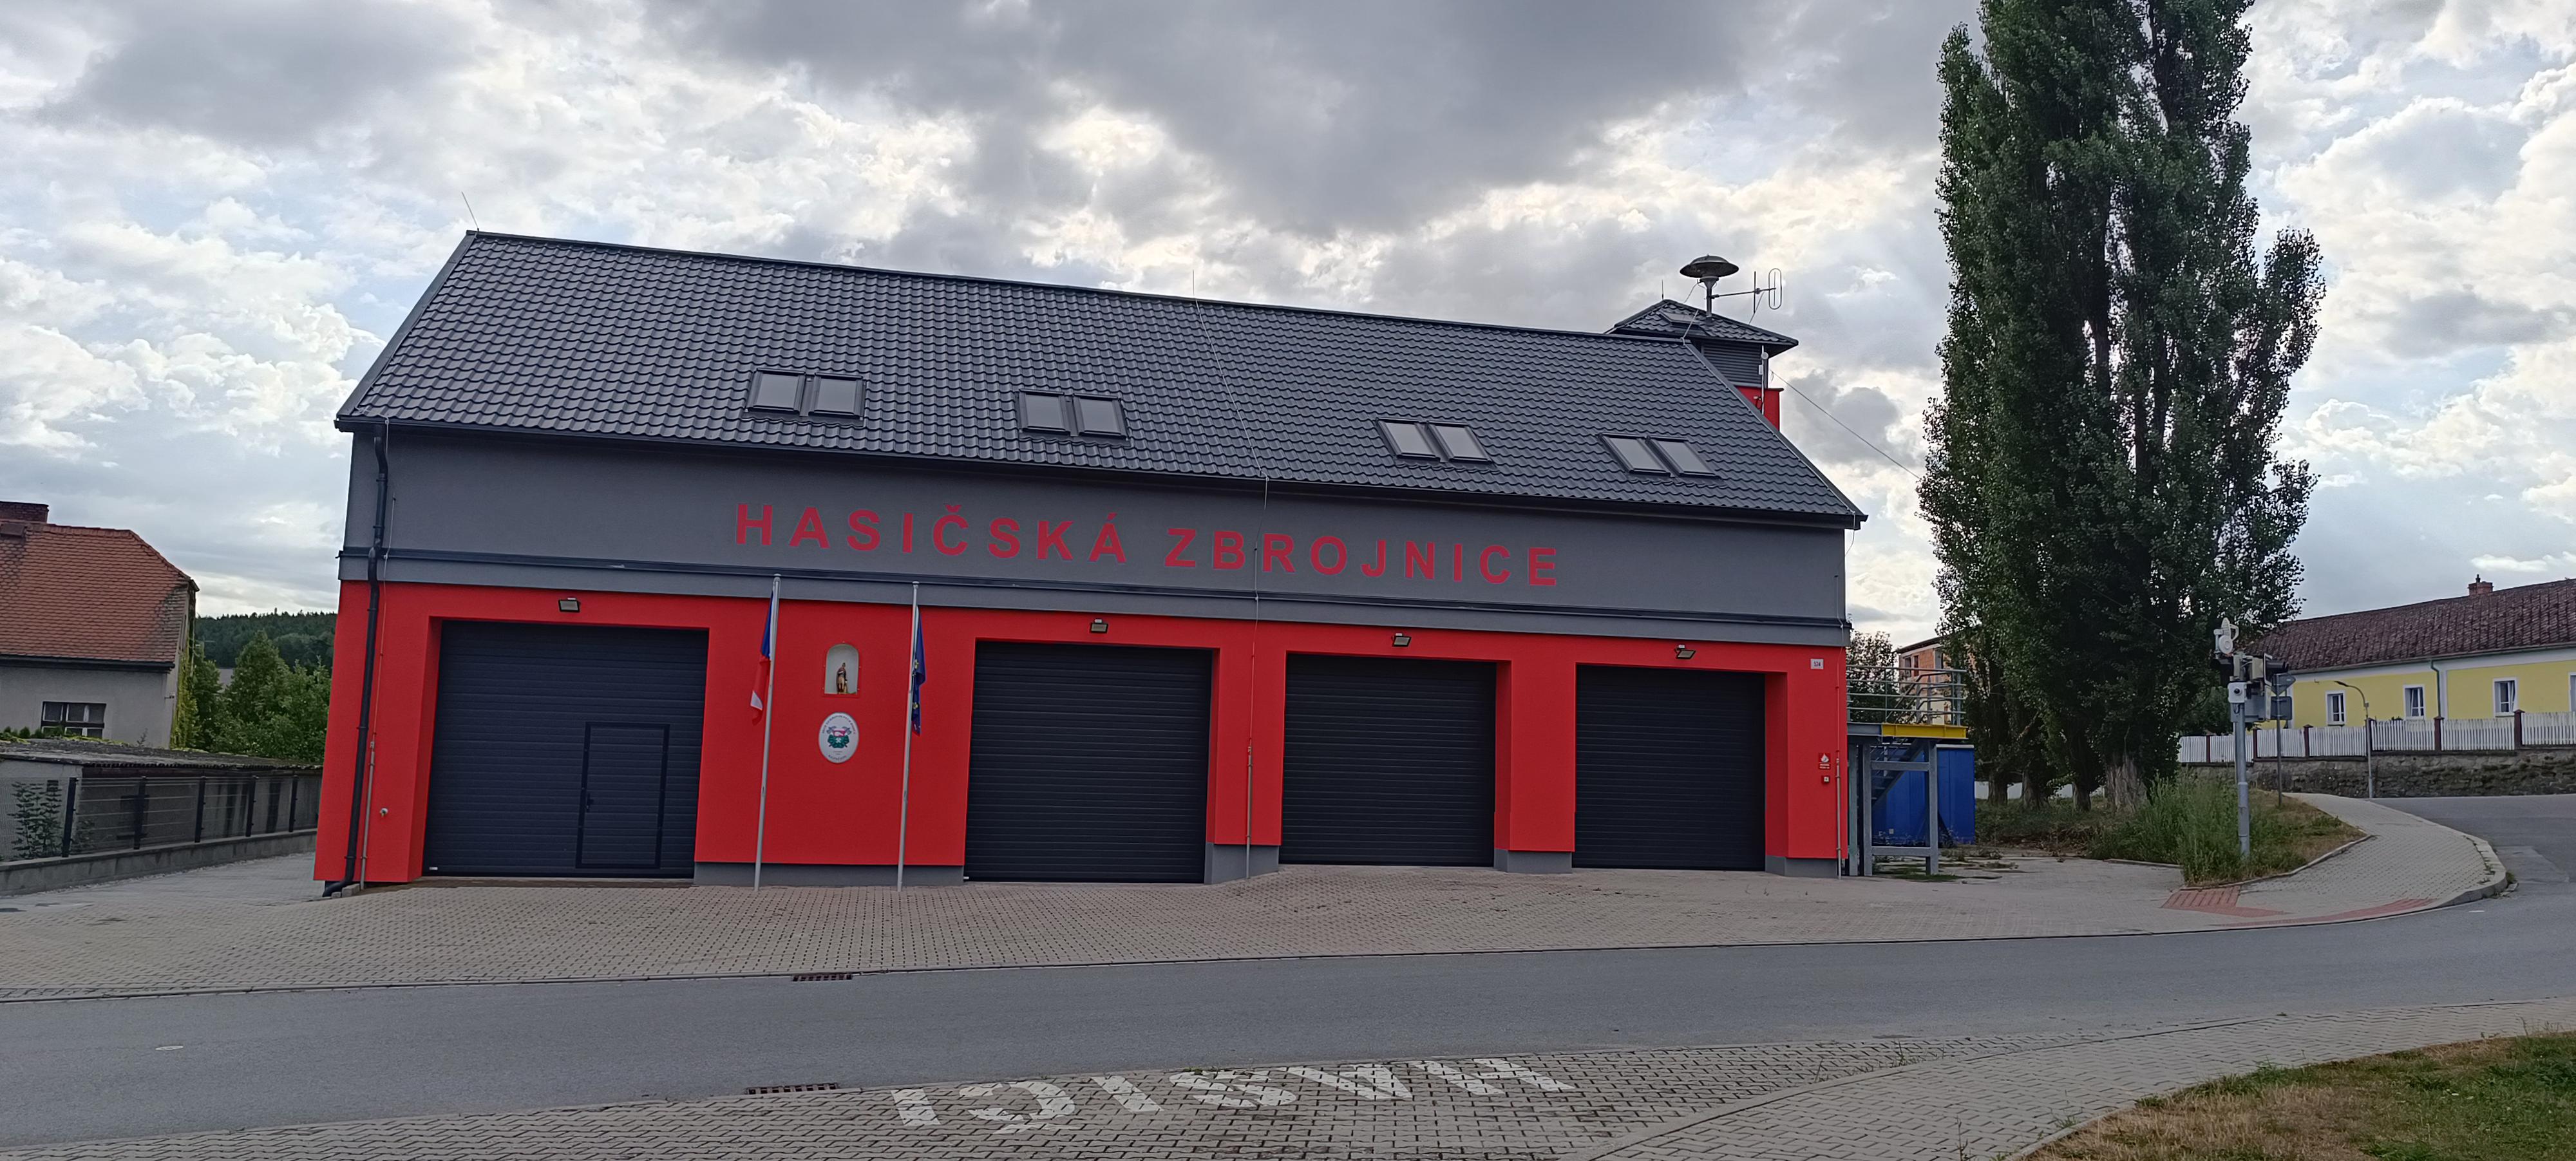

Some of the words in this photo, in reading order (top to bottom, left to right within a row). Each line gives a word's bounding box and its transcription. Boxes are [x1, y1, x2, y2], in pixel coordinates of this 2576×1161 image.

[736, 504, 1128, 564] HASIČSKÁ
[1164, 527, 1558, 587] ZBROJNICE
[891, 1058, 1577, 1134] HASIČI
